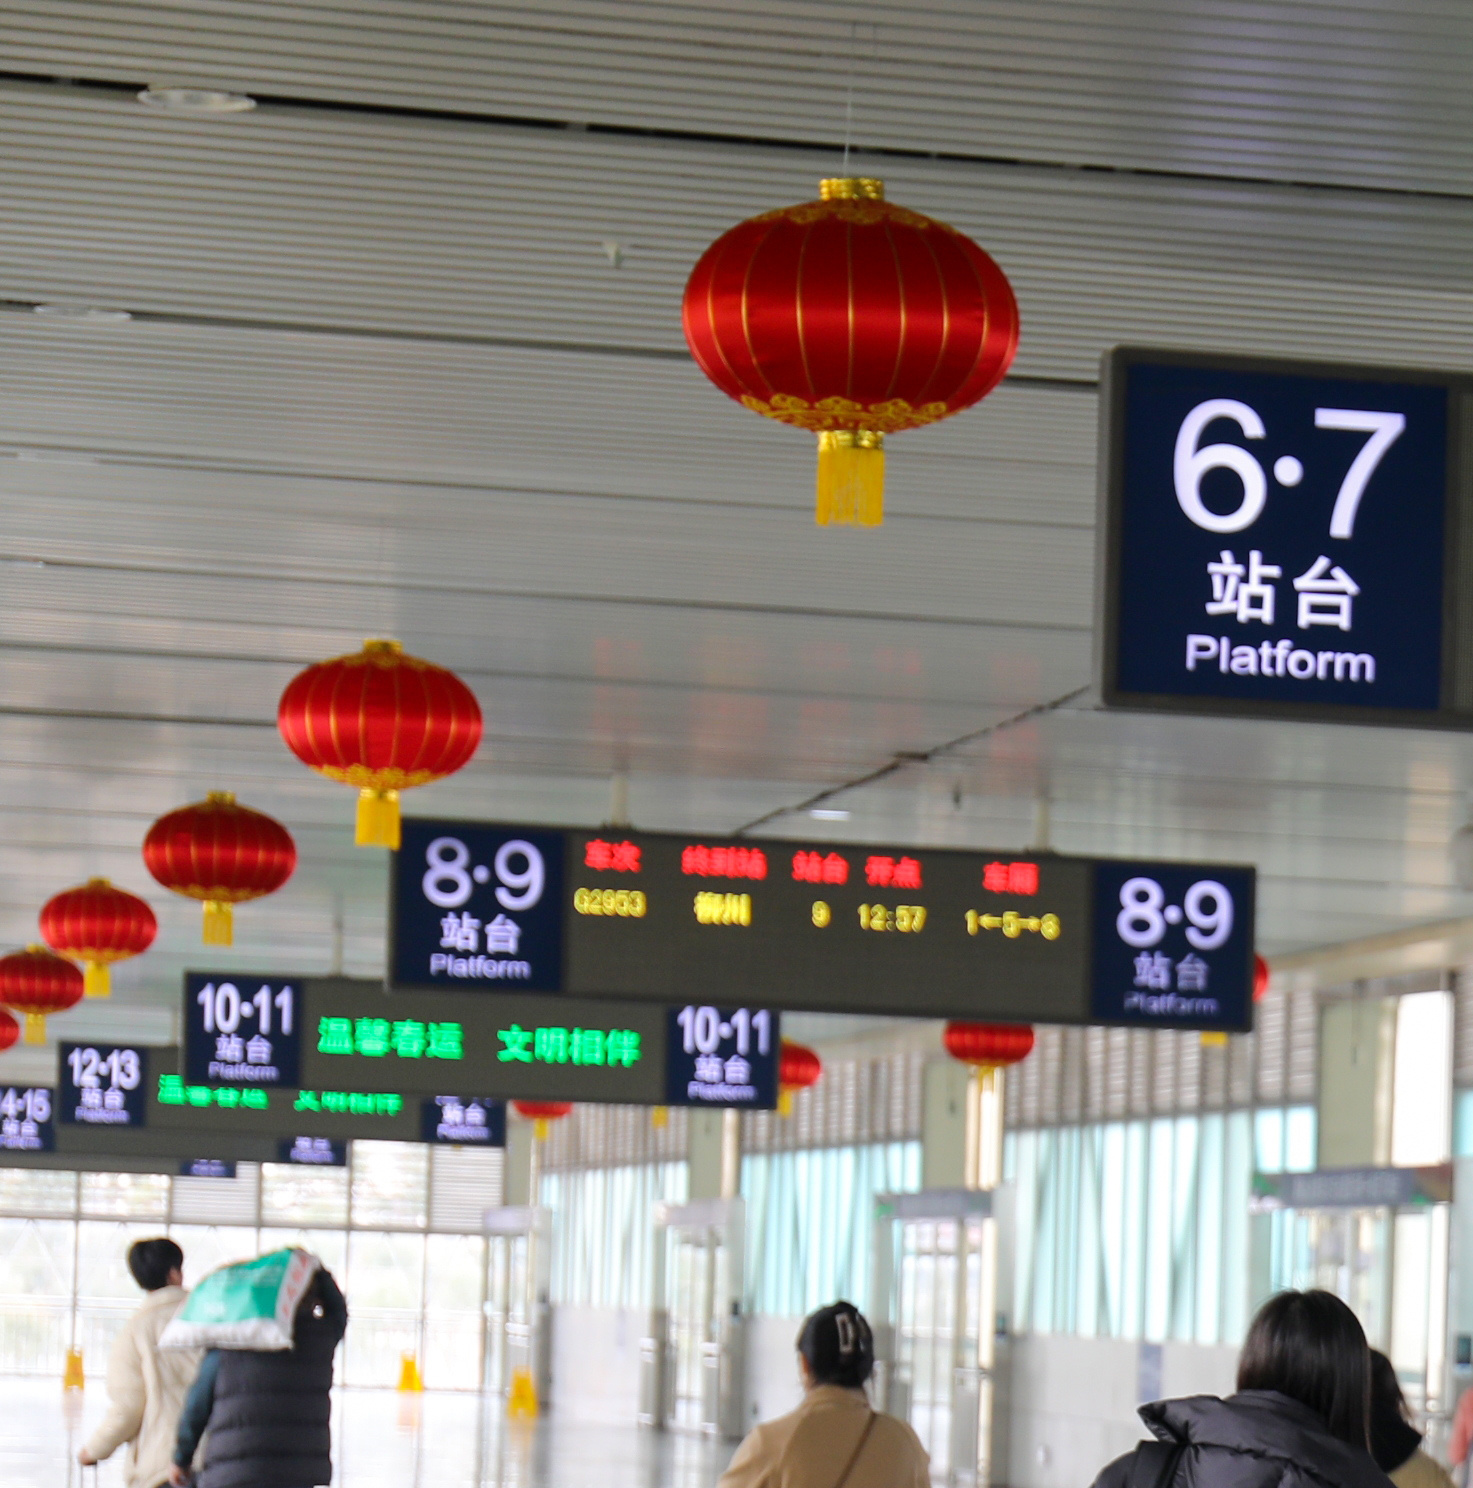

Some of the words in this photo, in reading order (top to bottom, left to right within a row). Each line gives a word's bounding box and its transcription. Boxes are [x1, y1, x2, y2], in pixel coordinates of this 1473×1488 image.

[1205, 549, 1361, 631] 站台
[1185, 633, 1376, 683] Platform
[439, 911, 521, 955] 站台
[811, 900, 831, 928] 9
[857, 903, 927, 933] 12:57
[429, 953, 531, 979] Platform
[1133, 950, 1209, 990] 站台
[1123, 990, 1219, 1016] Platform
[214, 1033, 272, 1065] 站台
[317, 1016, 464, 1060] 温馨春运
[496, 1023, 641, 1068] 文明相伴
[207, 1061, 280, 1081] Platform
[694, 1053, 751, 1085] 站台
[0, 1087, 51, 1124] 4·15
[80, 1087, 126, 1111] 站台
